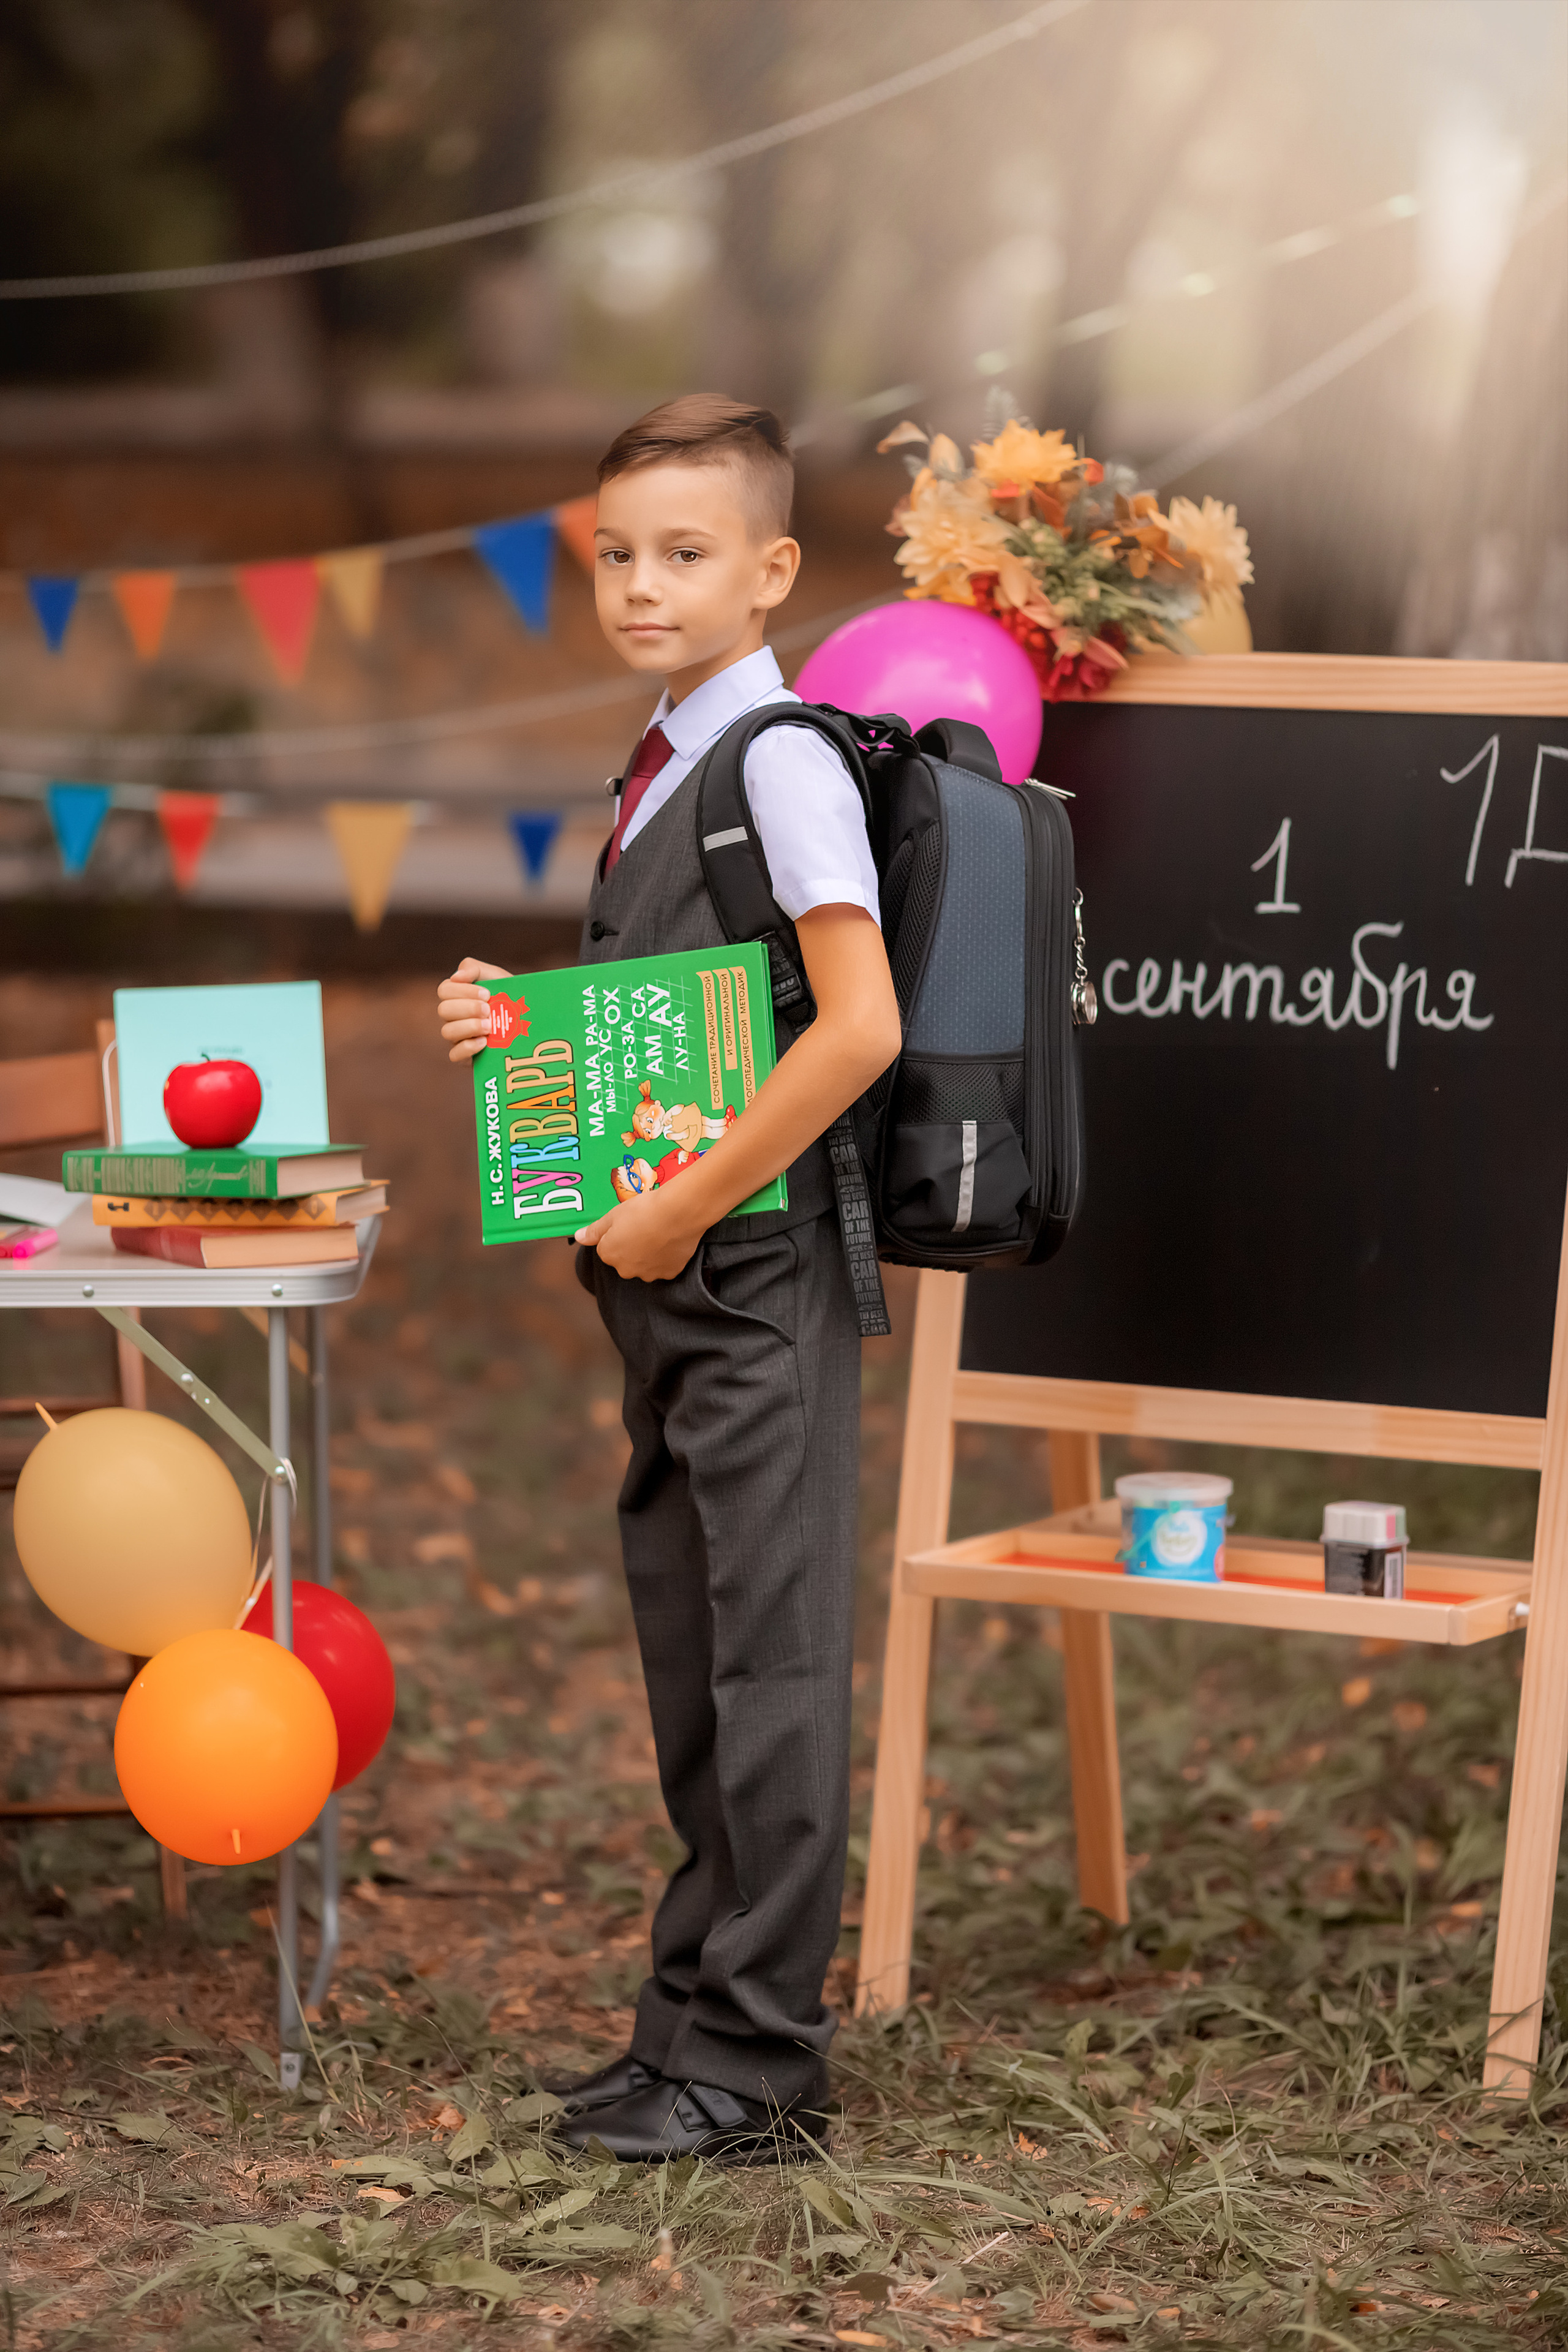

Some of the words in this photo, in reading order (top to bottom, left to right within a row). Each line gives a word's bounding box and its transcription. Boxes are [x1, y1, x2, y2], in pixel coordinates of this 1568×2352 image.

[1250, 817, 1302, 913] 1
[603, 987, 620, 1024] ОХ
[647, 983, 672, 1027] АУ
[704, 975, 717, 1050] ТРАДИЦИОННОЙ
[720, 973, 732, 1046] ОРИГИНАЛЬНОЙ
[737, 971, 746, 1014] МЕТОДИК
[1102, 921, 1494, 1070] сентября
[582, 984, 598, 1046] РА-МА
[622, 1020, 637, 1079] РО-ЗА
[631, 986, 646, 1017] СА
[599, 1029, 612, 1056] УС
[644, 1035, 663, 1075] АМ
[673, 1012, 688, 1070] ЛУ-НА
[585, 1054, 605, 1136] МА-МА
[603, 1062, 616, 1112] МЫ-ЛО
[710, 1052, 720, 1103] СОЧЕТАНИЕ
[485, 1077, 502, 1161] ЖУКОВА
[505, 1039, 583, 1219] БУКВАРЬ
[830, 1143, 858, 1164] CAR
[491, 1185, 504, 1205] Н.
[837, 1173, 862, 1186] FUTURE
[842, 1200, 869, 1221] CAR
[845, 1221, 855, 1234] OF
[856, 1219, 870, 1232] THE
[846, 1232, 871, 1245] FUTURE
[860, 1251, 873, 1259] BEST
[851, 1260, 877, 1280] CAR
[853, 1280, 862, 1292] OF
[864, 1279, 879, 1291] THE
[856, 1291, 881, 1303] FUTURE
